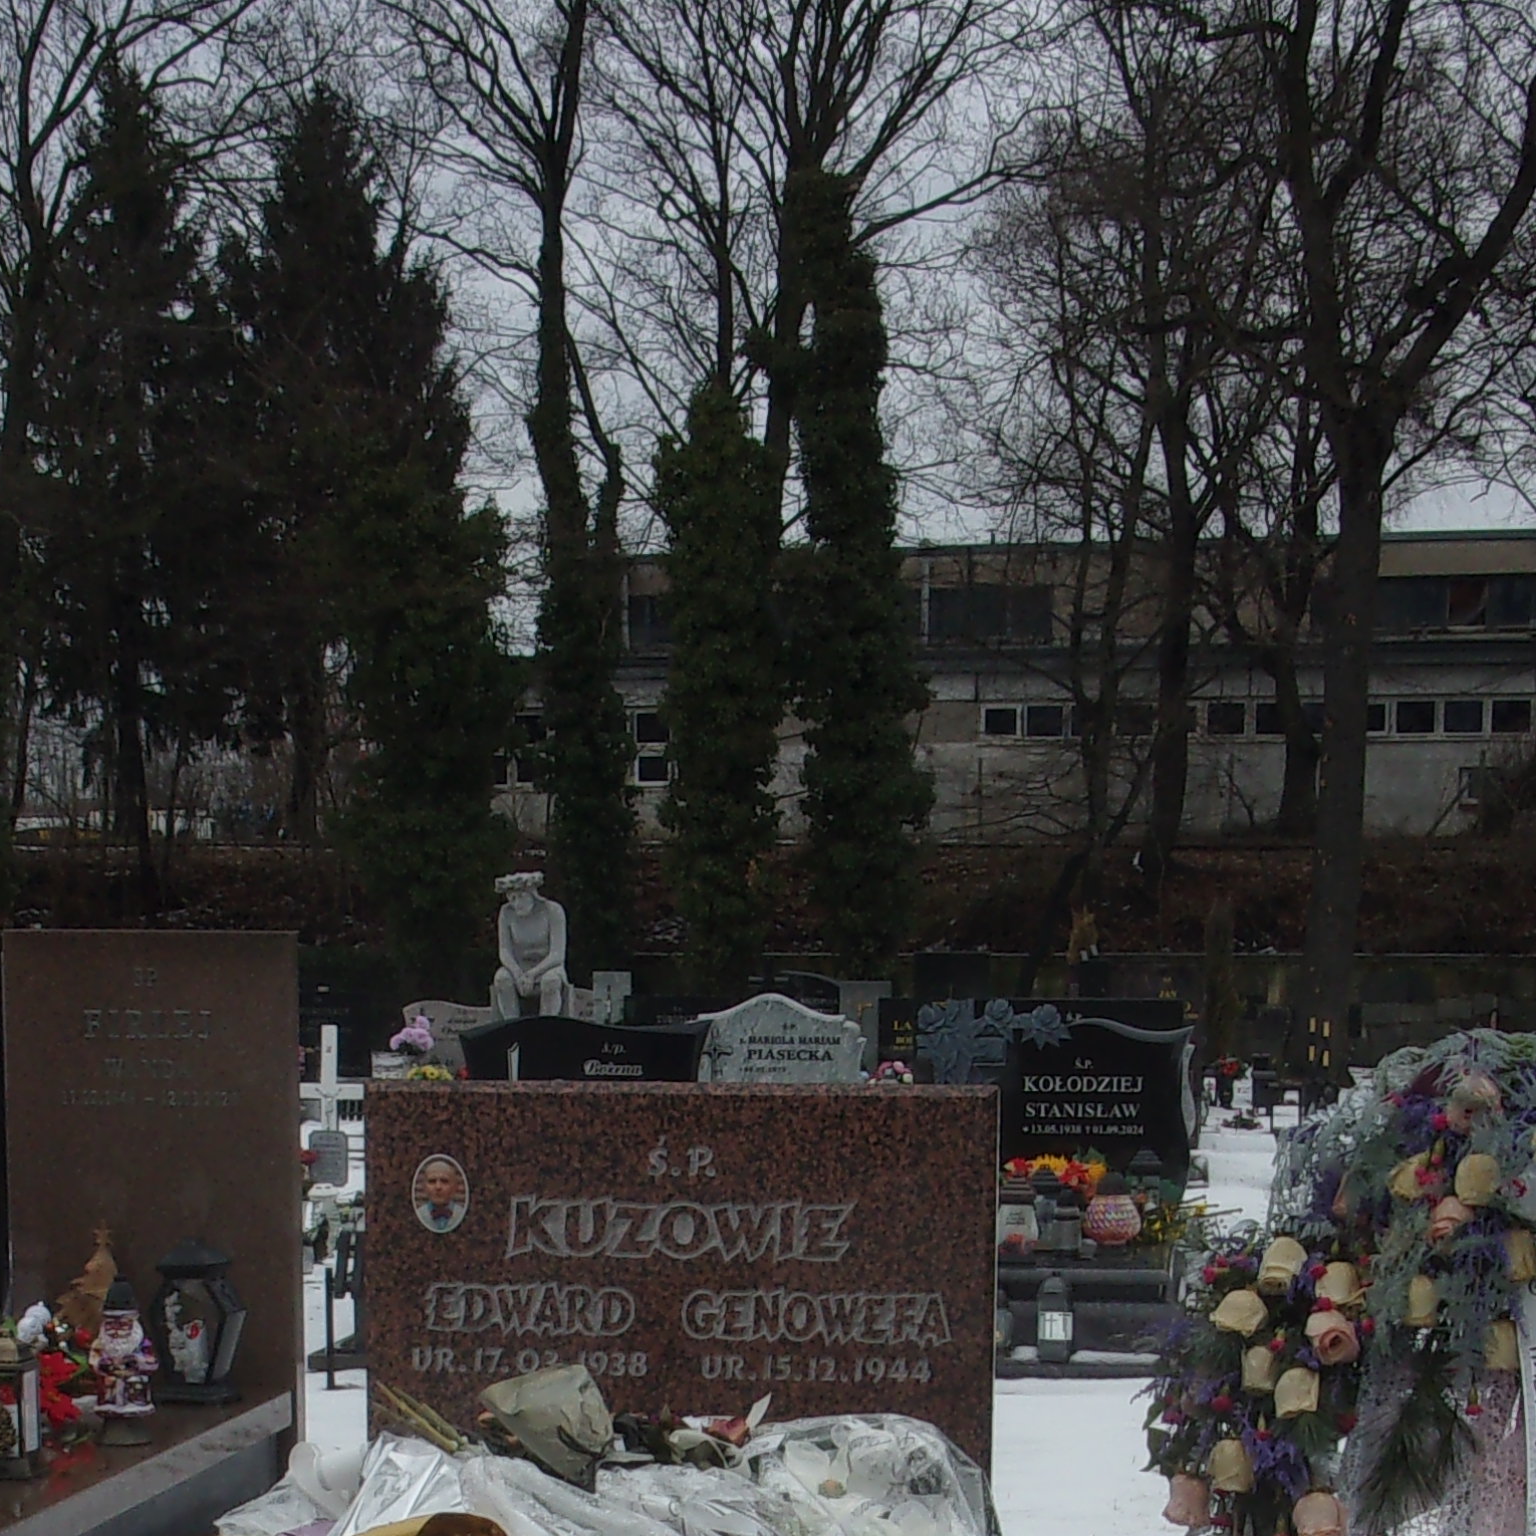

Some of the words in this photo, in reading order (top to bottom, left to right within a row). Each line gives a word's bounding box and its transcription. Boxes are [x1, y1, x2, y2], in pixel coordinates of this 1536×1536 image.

[747, 1050, 833, 1062] PIASECKA
[1023, 1075, 1144, 1093] KOŁODZIEJ
[1024, 1102, 1141, 1118] STANISŁAW
[426, 1281, 635, 1337] EDWARD
[682, 1286, 953, 1346] GENOWEFA
